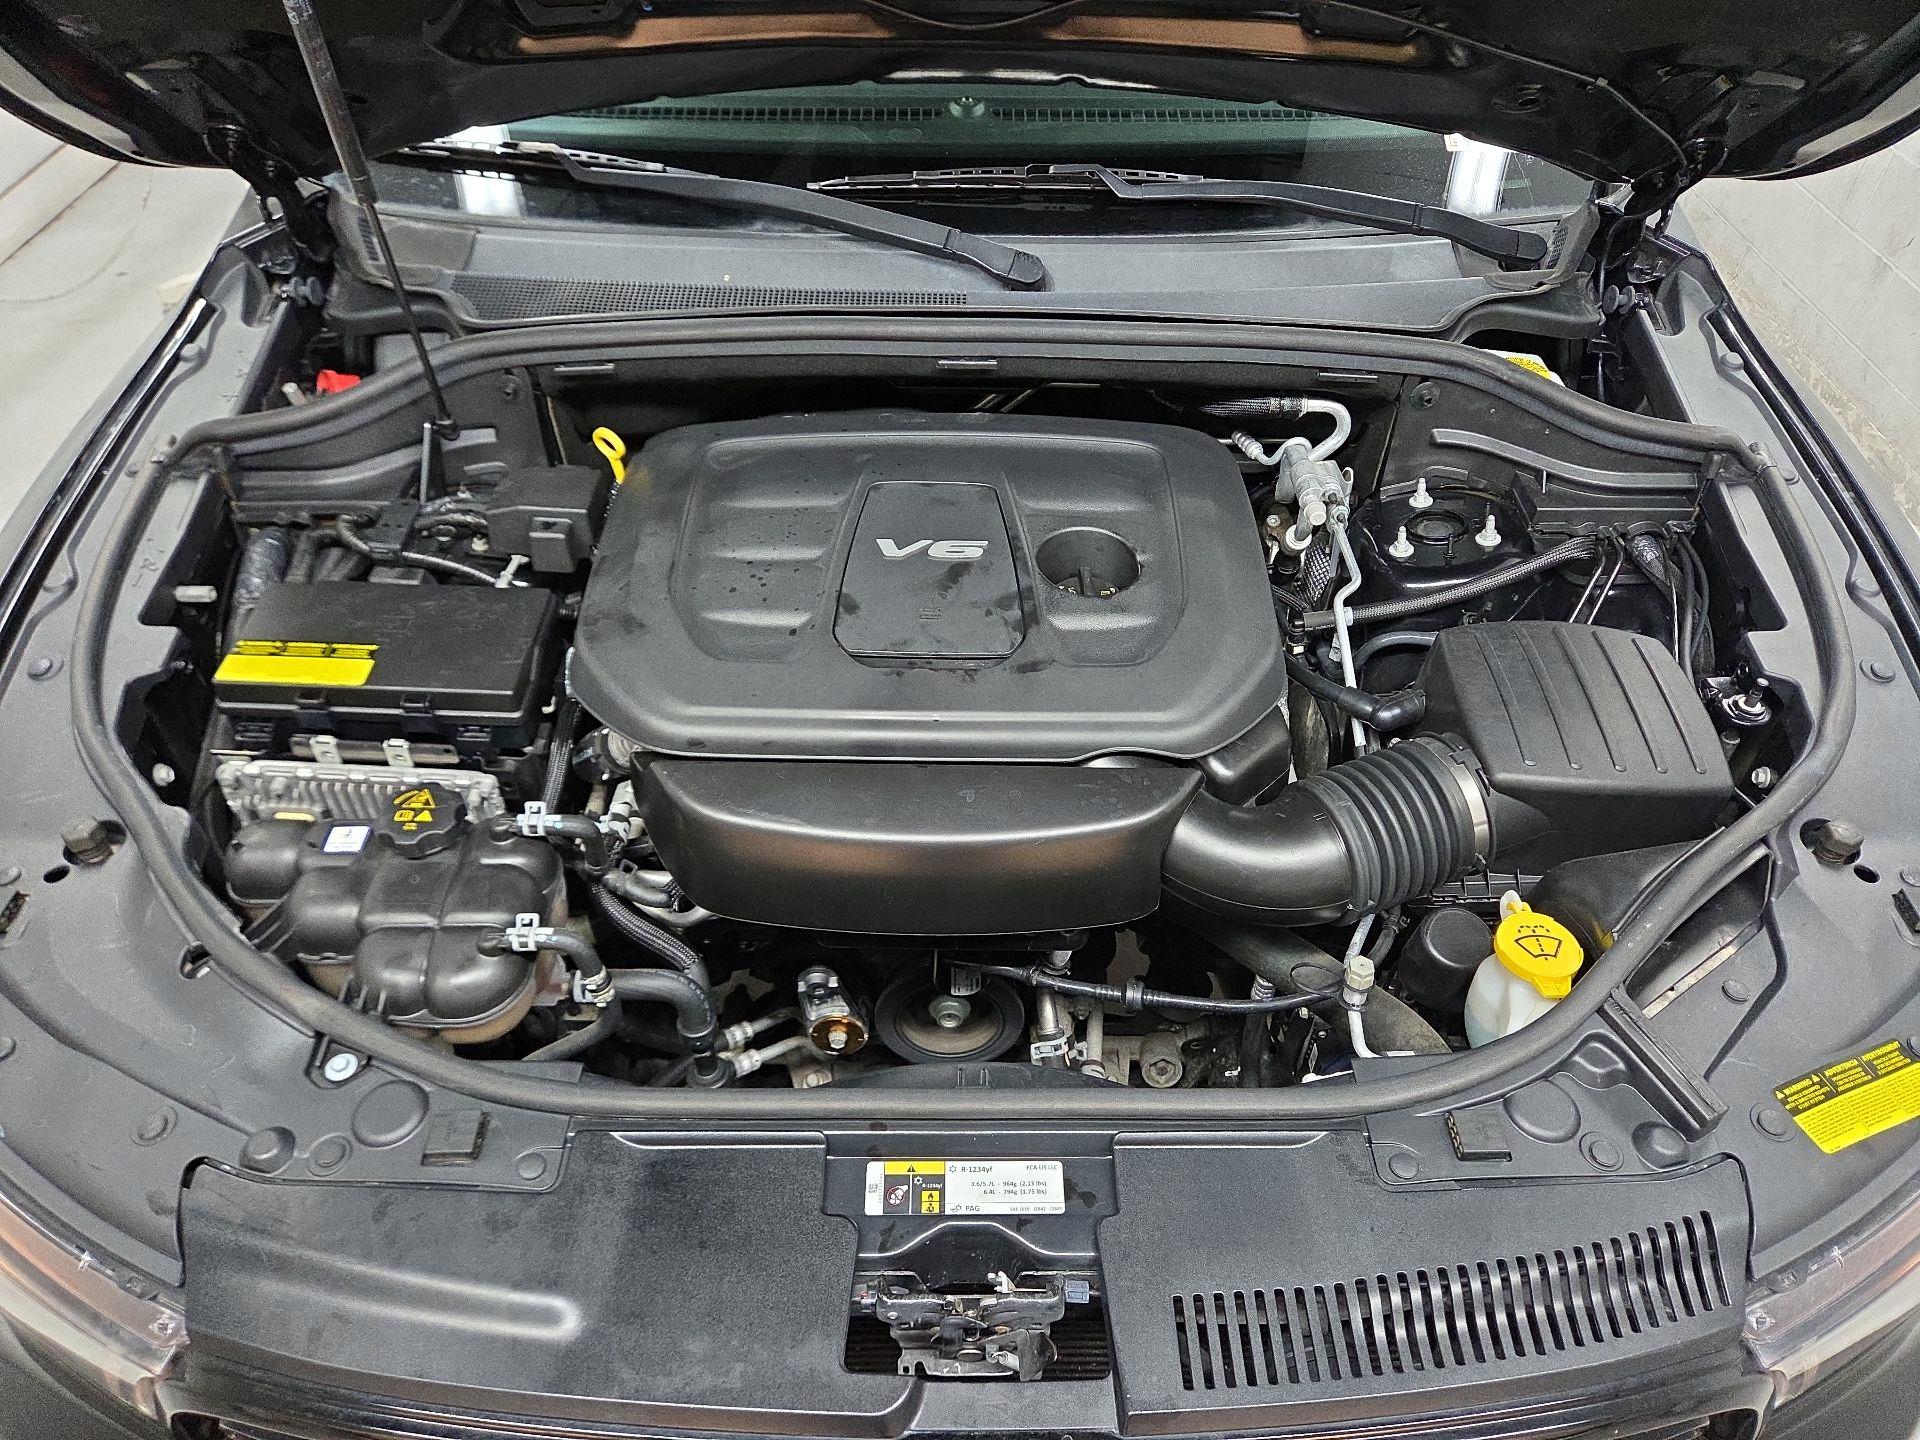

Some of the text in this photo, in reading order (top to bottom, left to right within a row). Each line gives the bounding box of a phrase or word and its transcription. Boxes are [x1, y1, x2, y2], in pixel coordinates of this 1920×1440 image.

[876, 538, 989, 561] V6
[1783, 1079, 1812, 1096] WARNING
[961, 1165, 993, 1174] R-1234yf
